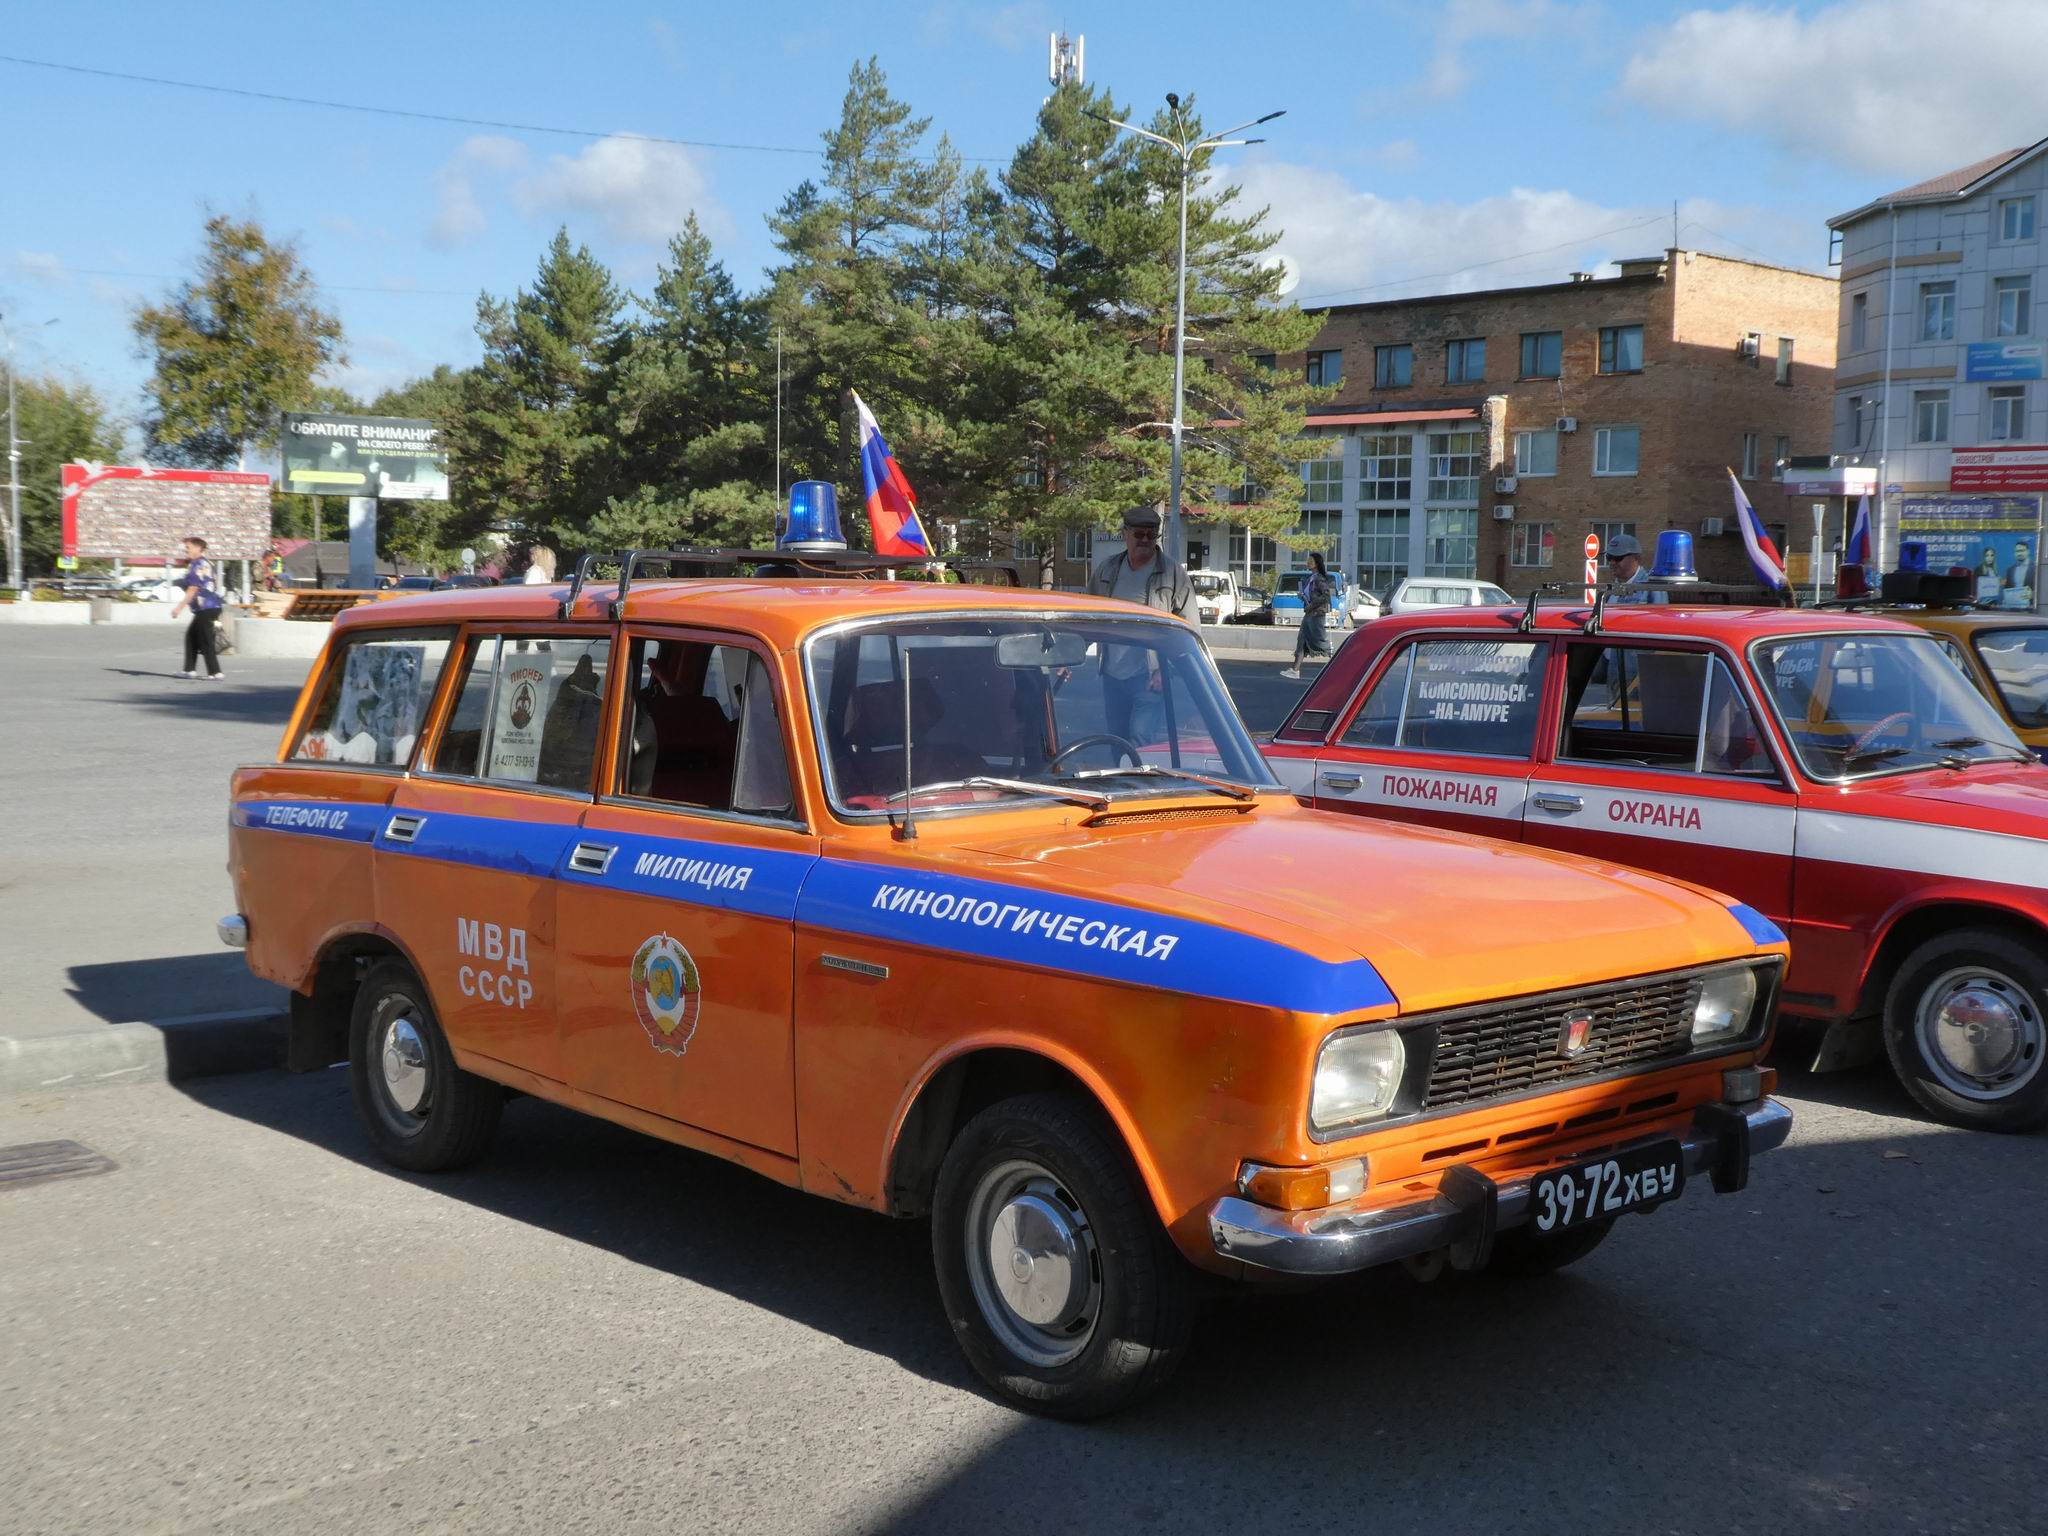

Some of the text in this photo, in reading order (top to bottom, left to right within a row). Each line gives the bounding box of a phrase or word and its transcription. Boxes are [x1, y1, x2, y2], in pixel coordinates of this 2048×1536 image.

[291, 421, 359, 437] ОБРАТИТЕ
[357, 439, 370, 448] НА
[371, 440, 402, 450] СВОЕГО
[511, 668, 543, 683] ПИОНЕР
[1419, 681, 1535, 702] КОМСОМОЛЬСК-
[1429, 702, 1511, 723] -НА-АМУРЕ
[1382, 774, 1499, 808] ПОЖАРНАЯ
[265, 805, 349, 831] ТЕЛЕФОН 02
[1607, 799, 1702, 830] ОХРАНА
[634, 852, 753, 891] МИЛИЦИЯ
[872, 883, 1180, 961] КИНОЛОГИЧЕСКАЯ
[457, 917, 530, 975] МВД
[459, 966, 533, 1009] СССР
